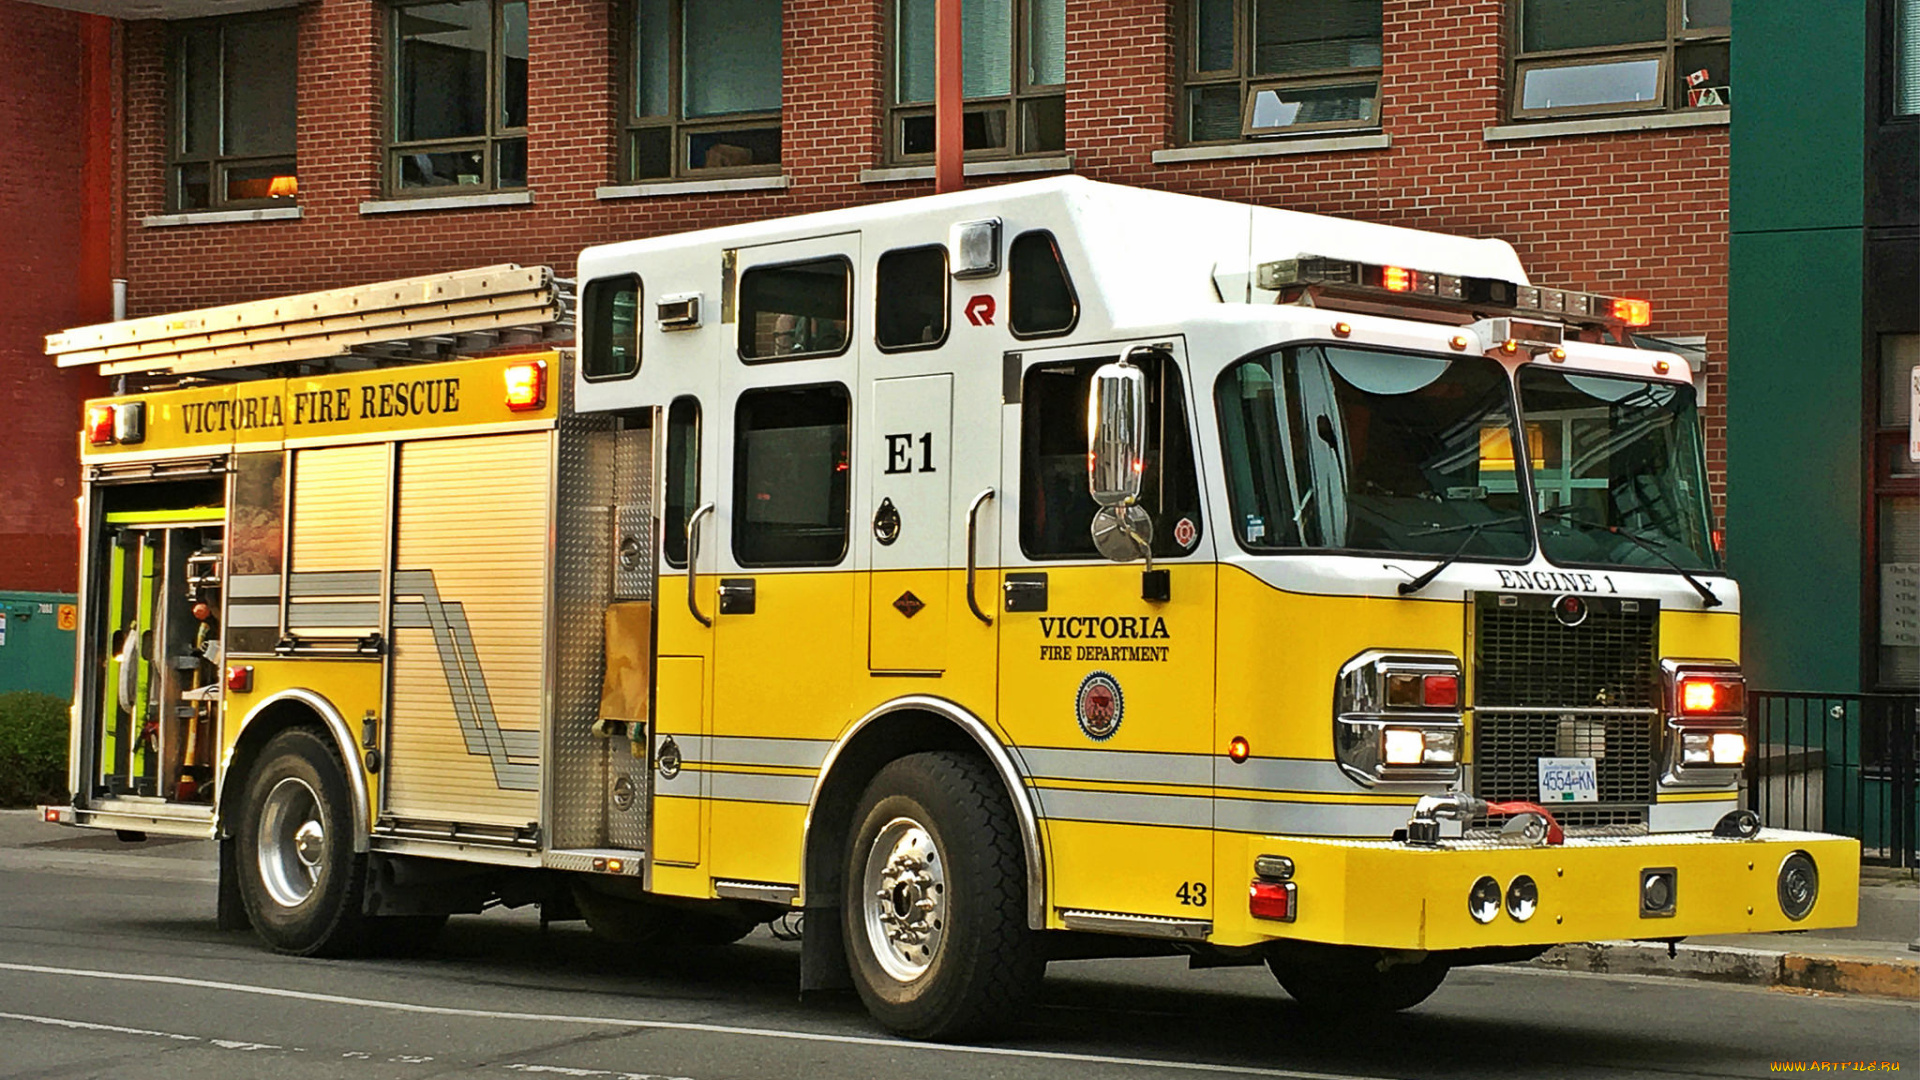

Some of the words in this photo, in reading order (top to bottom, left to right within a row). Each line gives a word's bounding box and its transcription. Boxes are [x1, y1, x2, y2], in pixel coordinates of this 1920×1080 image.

[182, 395, 284, 434] VICTORIA
[293, 388, 351, 425] FIRE
[360, 378, 460, 419] RESCUE
[884, 432, 936, 474] E1
[1495, 569, 1597, 592] ENGINE
[1604, 575, 1618, 594] 1
[1038, 616, 1170, 639] VICTORIA
[1040, 645, 1072, 660] FIRE
[1076, 646, 1170, 662] DEPARTMENT
[1175, 881, 1207, 907] 43
